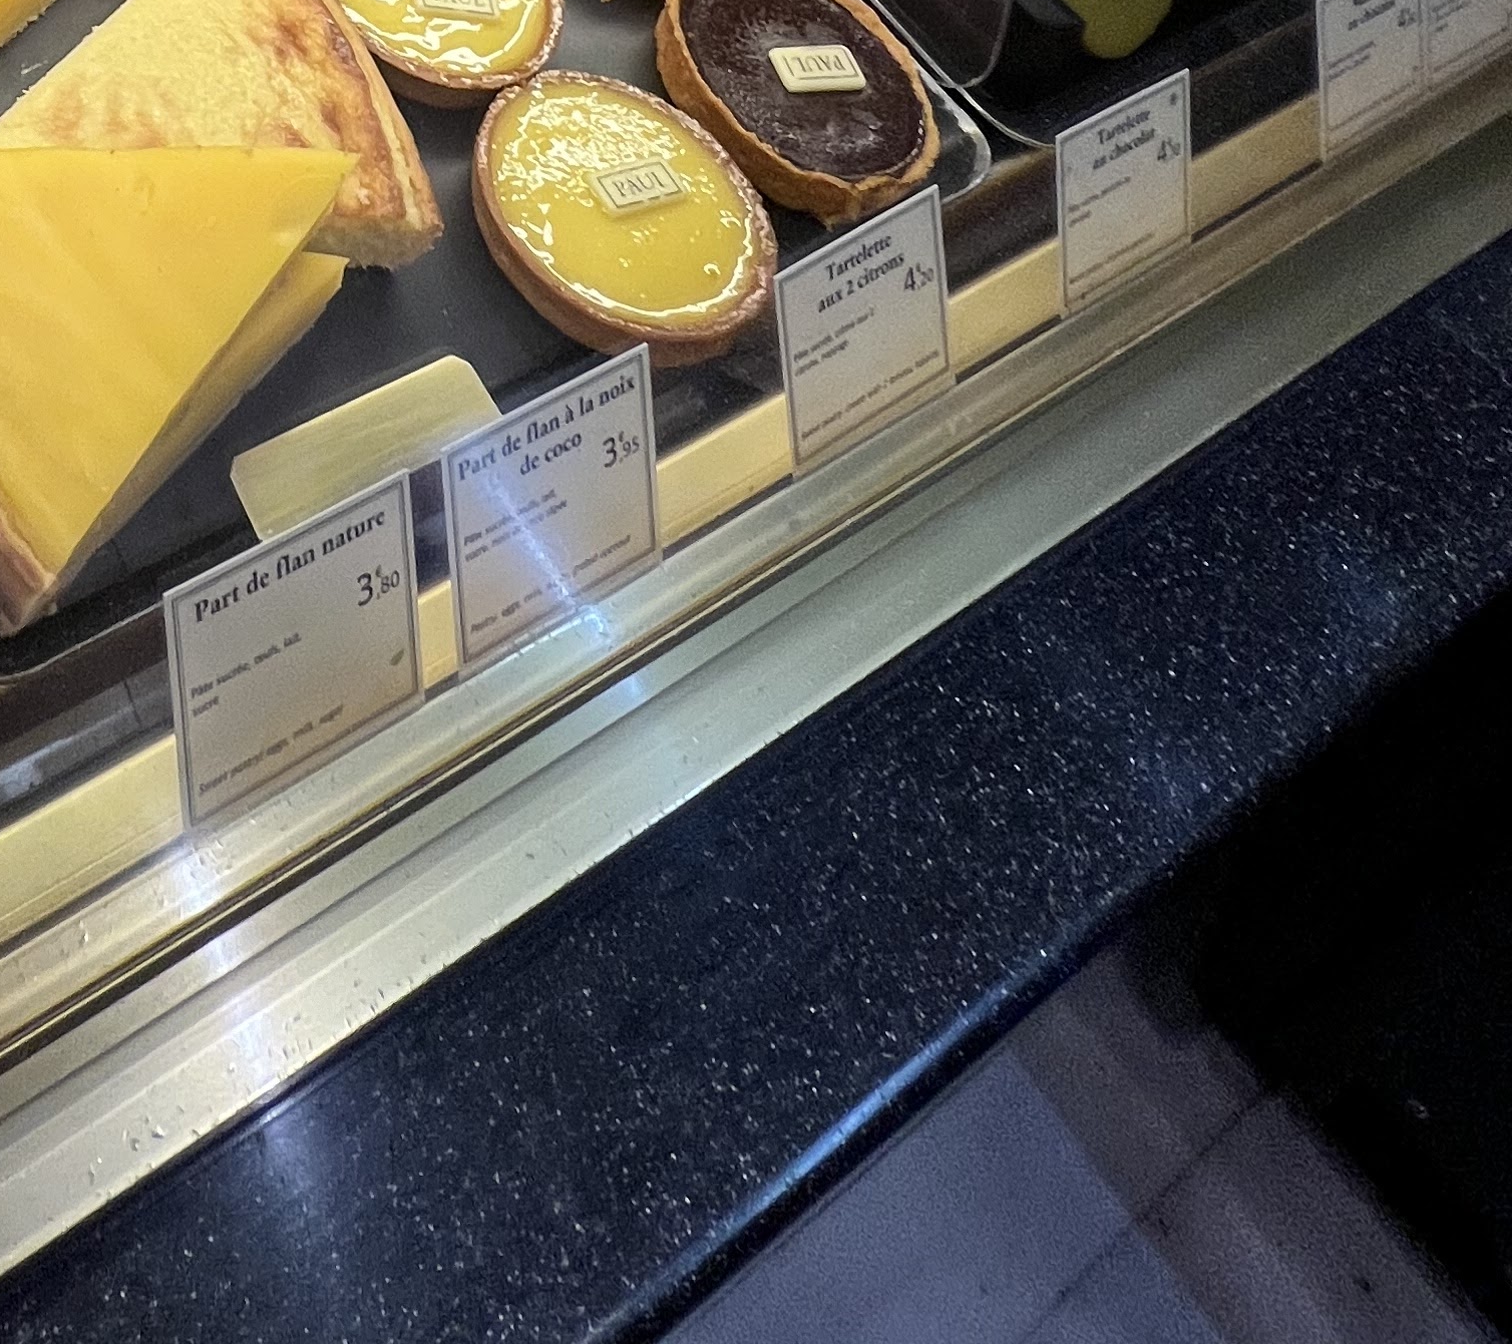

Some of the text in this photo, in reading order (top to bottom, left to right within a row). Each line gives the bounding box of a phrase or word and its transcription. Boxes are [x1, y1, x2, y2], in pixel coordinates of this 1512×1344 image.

[795, 53, 846, 73] PAUL
[612, 170, 667, 196] PAUL
[826, 235, 892, 282] Tartelette
[818, 252, 905, 313] aux 2 citrons
[457, 374, 636, 481] Part de flan à la noix
[520, 434, 583, 476] de coco
[194, 509, 386, 624] Part de flan nature
